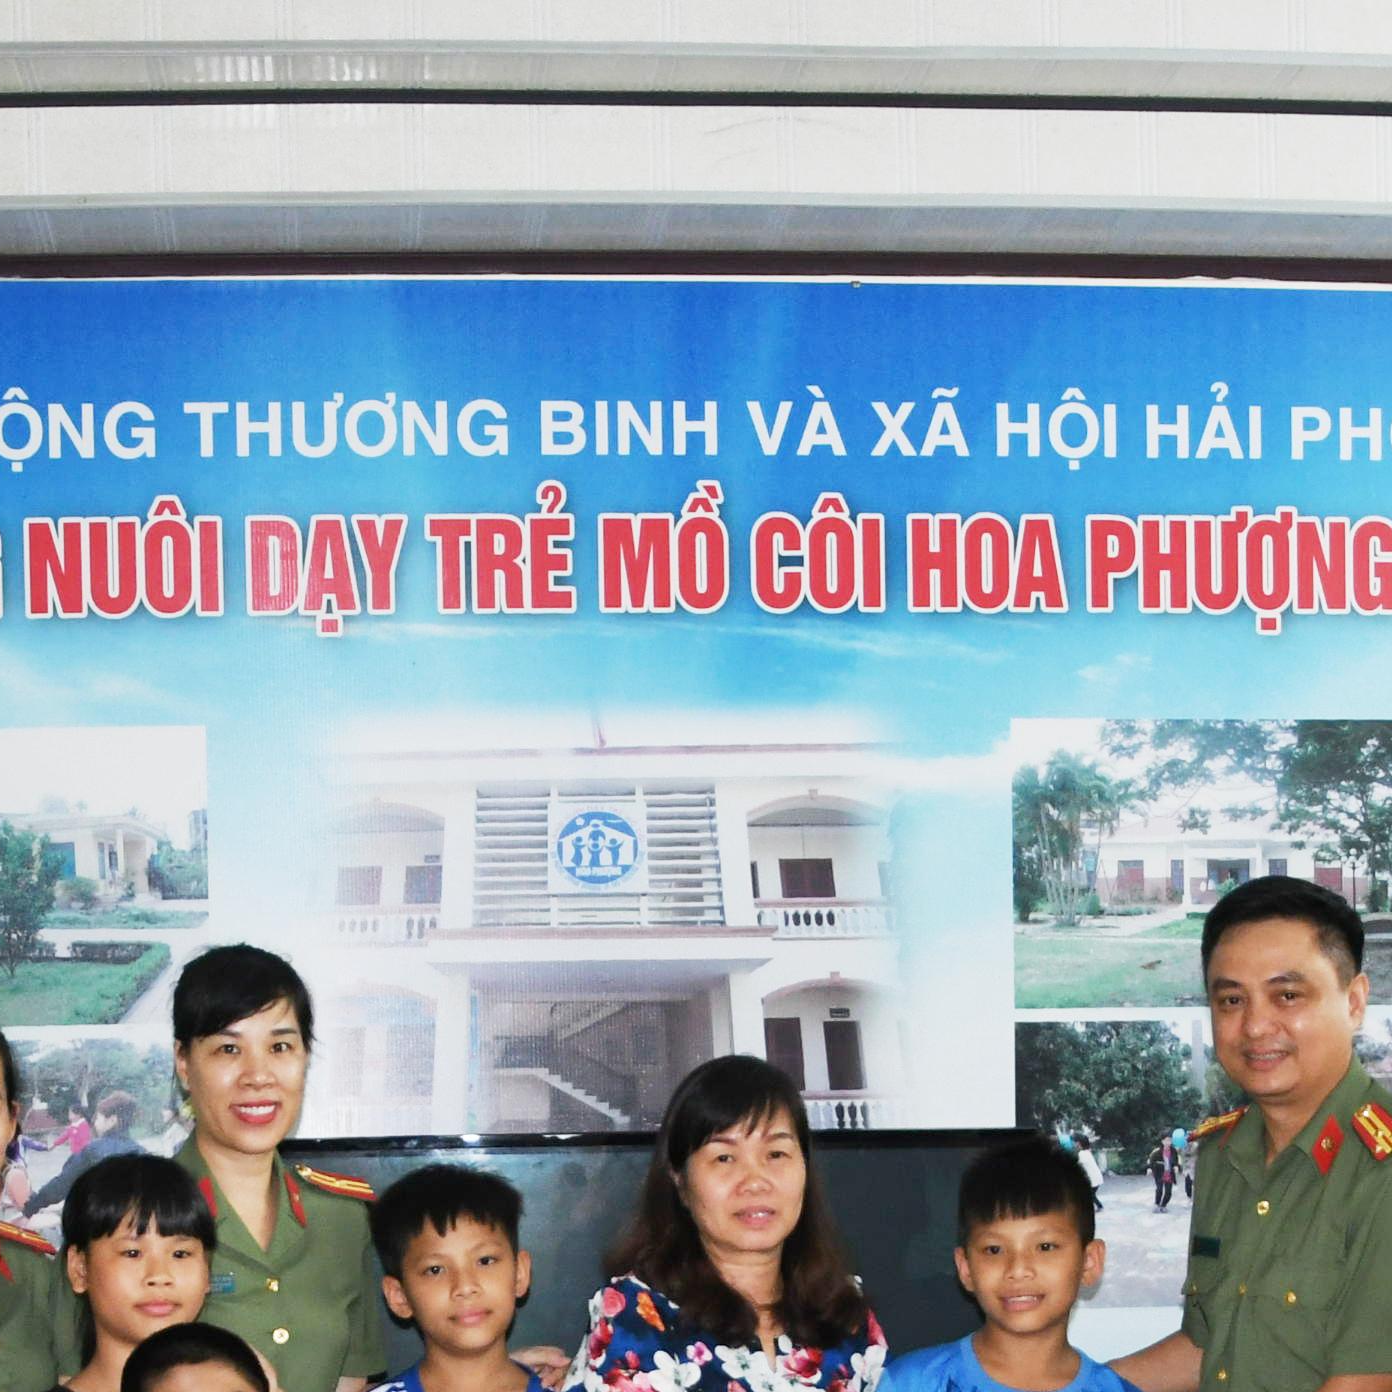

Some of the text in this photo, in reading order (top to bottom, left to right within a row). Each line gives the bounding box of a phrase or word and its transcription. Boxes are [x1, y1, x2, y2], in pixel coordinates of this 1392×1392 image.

[184, 391, 510, 461] THƯƠNG
[539, 399, 719, 458] BINH
[746, 385, 848, 458] VÀ
[871, 387, 972, 458] XÃ
[995, 387, 1118, 471] HỘI
[1146, 384, 1262, 461] HẢI
[22, 494, 223, 620] NUÔI
[244, 511, 409, 639] DẠY
[425, 480, 578, 615] TRẺ
[597, 479, 731, 615] MỒ
[750, 491, 887, 615] CÔI
[905, 510, 1068, 615] HOA
